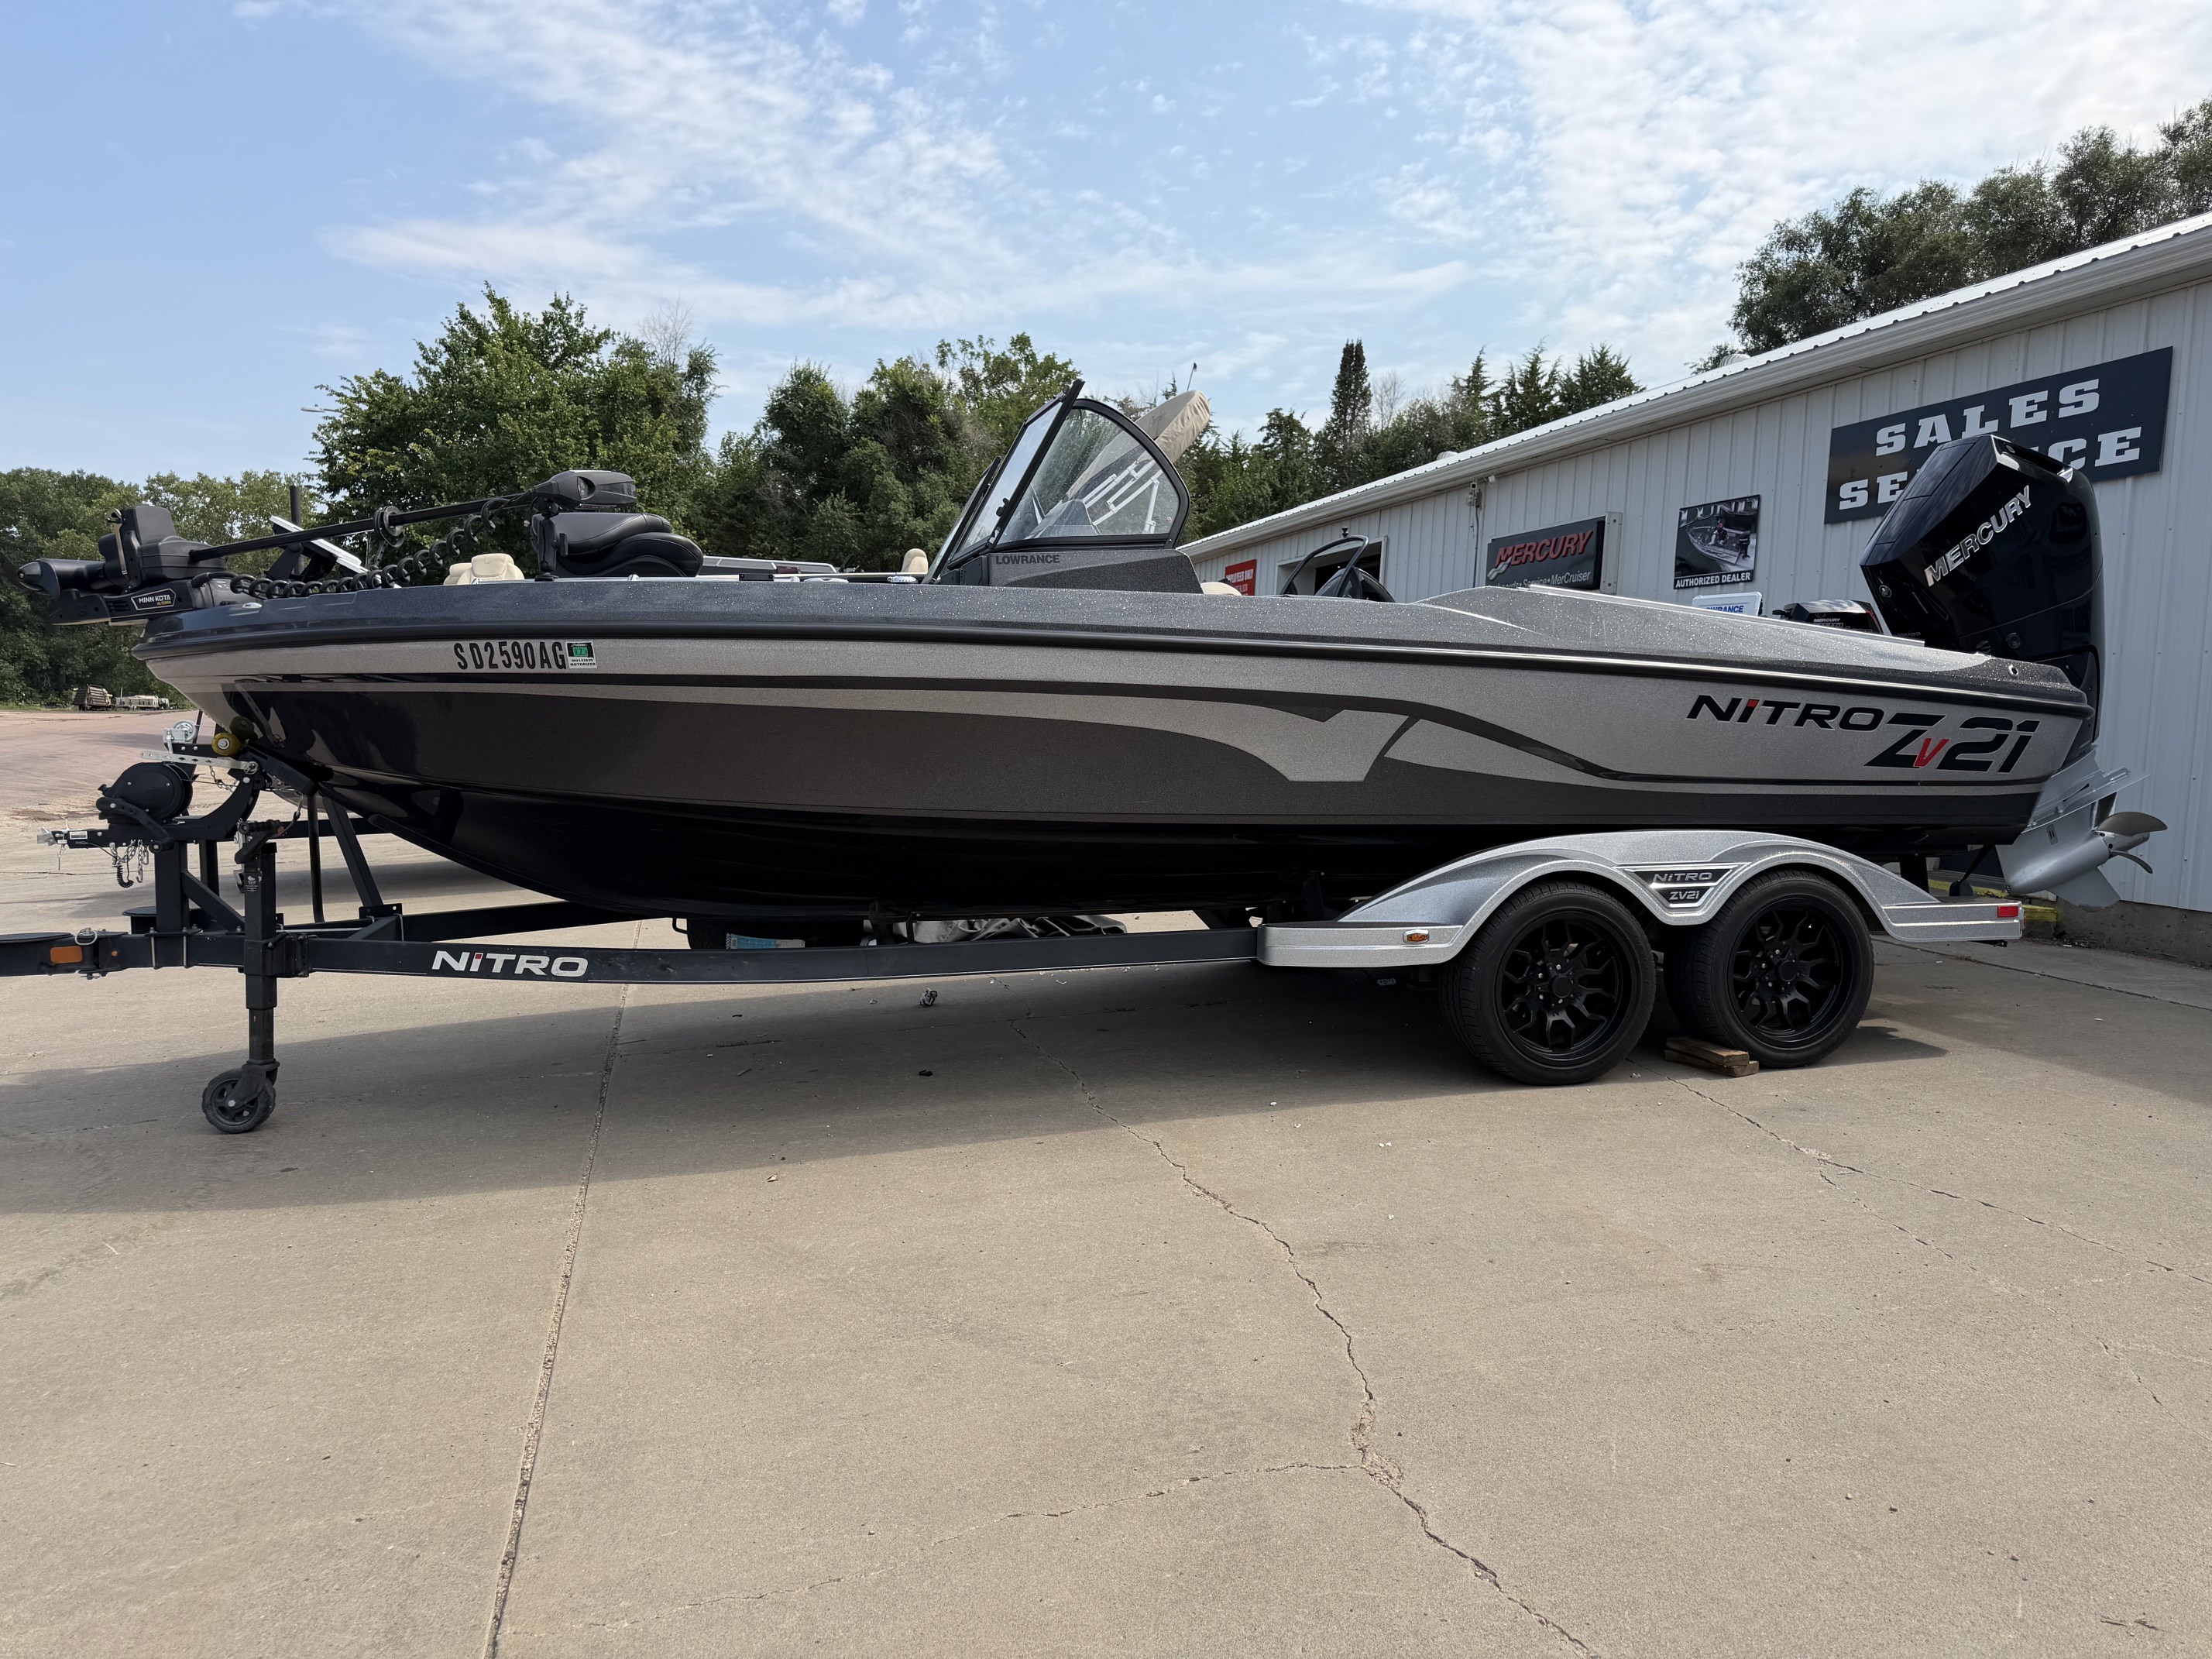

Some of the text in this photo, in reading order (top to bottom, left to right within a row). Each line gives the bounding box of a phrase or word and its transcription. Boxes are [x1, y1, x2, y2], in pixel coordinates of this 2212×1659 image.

[1876, 379, 2100, 456] SALES
[1839, 427, 2142, 510] SECE
[1679, 498, 1759, 527] LUND
[1495, 531, 1593, 567] MERCURY
[1924, 485, 2031, 586] MERCURY
[996, 555, 1060, 564] LOWRANCE
[1551, 571, 1591, 585] MerCruiser
[1675, 572, 1750, 588] AUTHORIZED DEALER
[454, 641, 567, 669] SD2590AG
